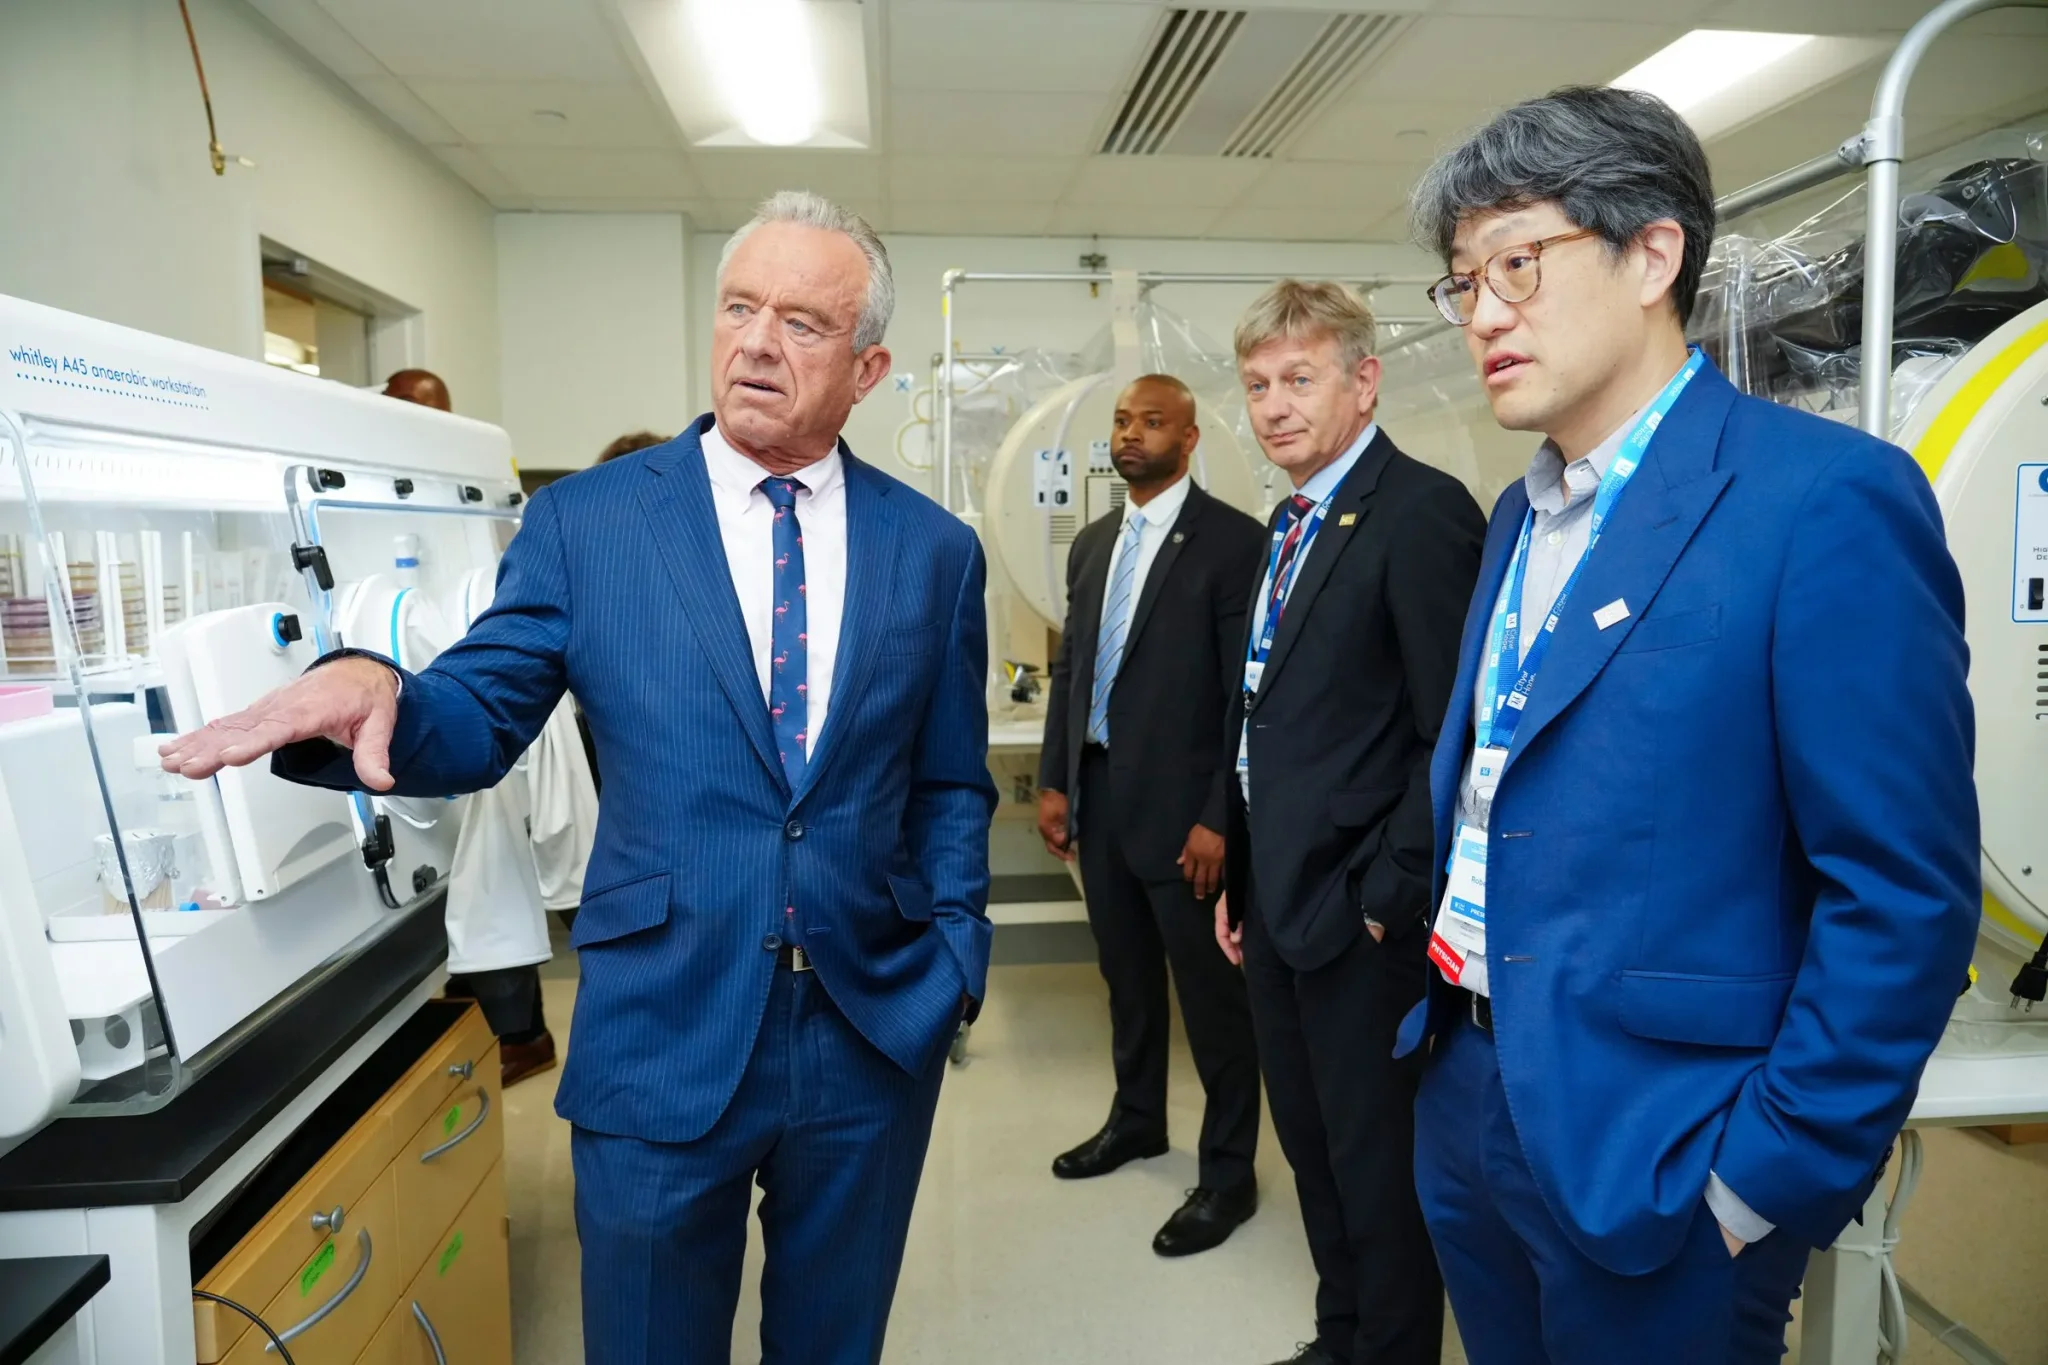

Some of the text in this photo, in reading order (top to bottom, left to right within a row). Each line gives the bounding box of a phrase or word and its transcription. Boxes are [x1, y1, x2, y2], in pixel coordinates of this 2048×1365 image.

[9, 345, 206, 398] whitley A45 anaerobic workstation
[1514, 676, 1527, 692] City
[1431, 941, 1460, 975] PHYSICIAN
